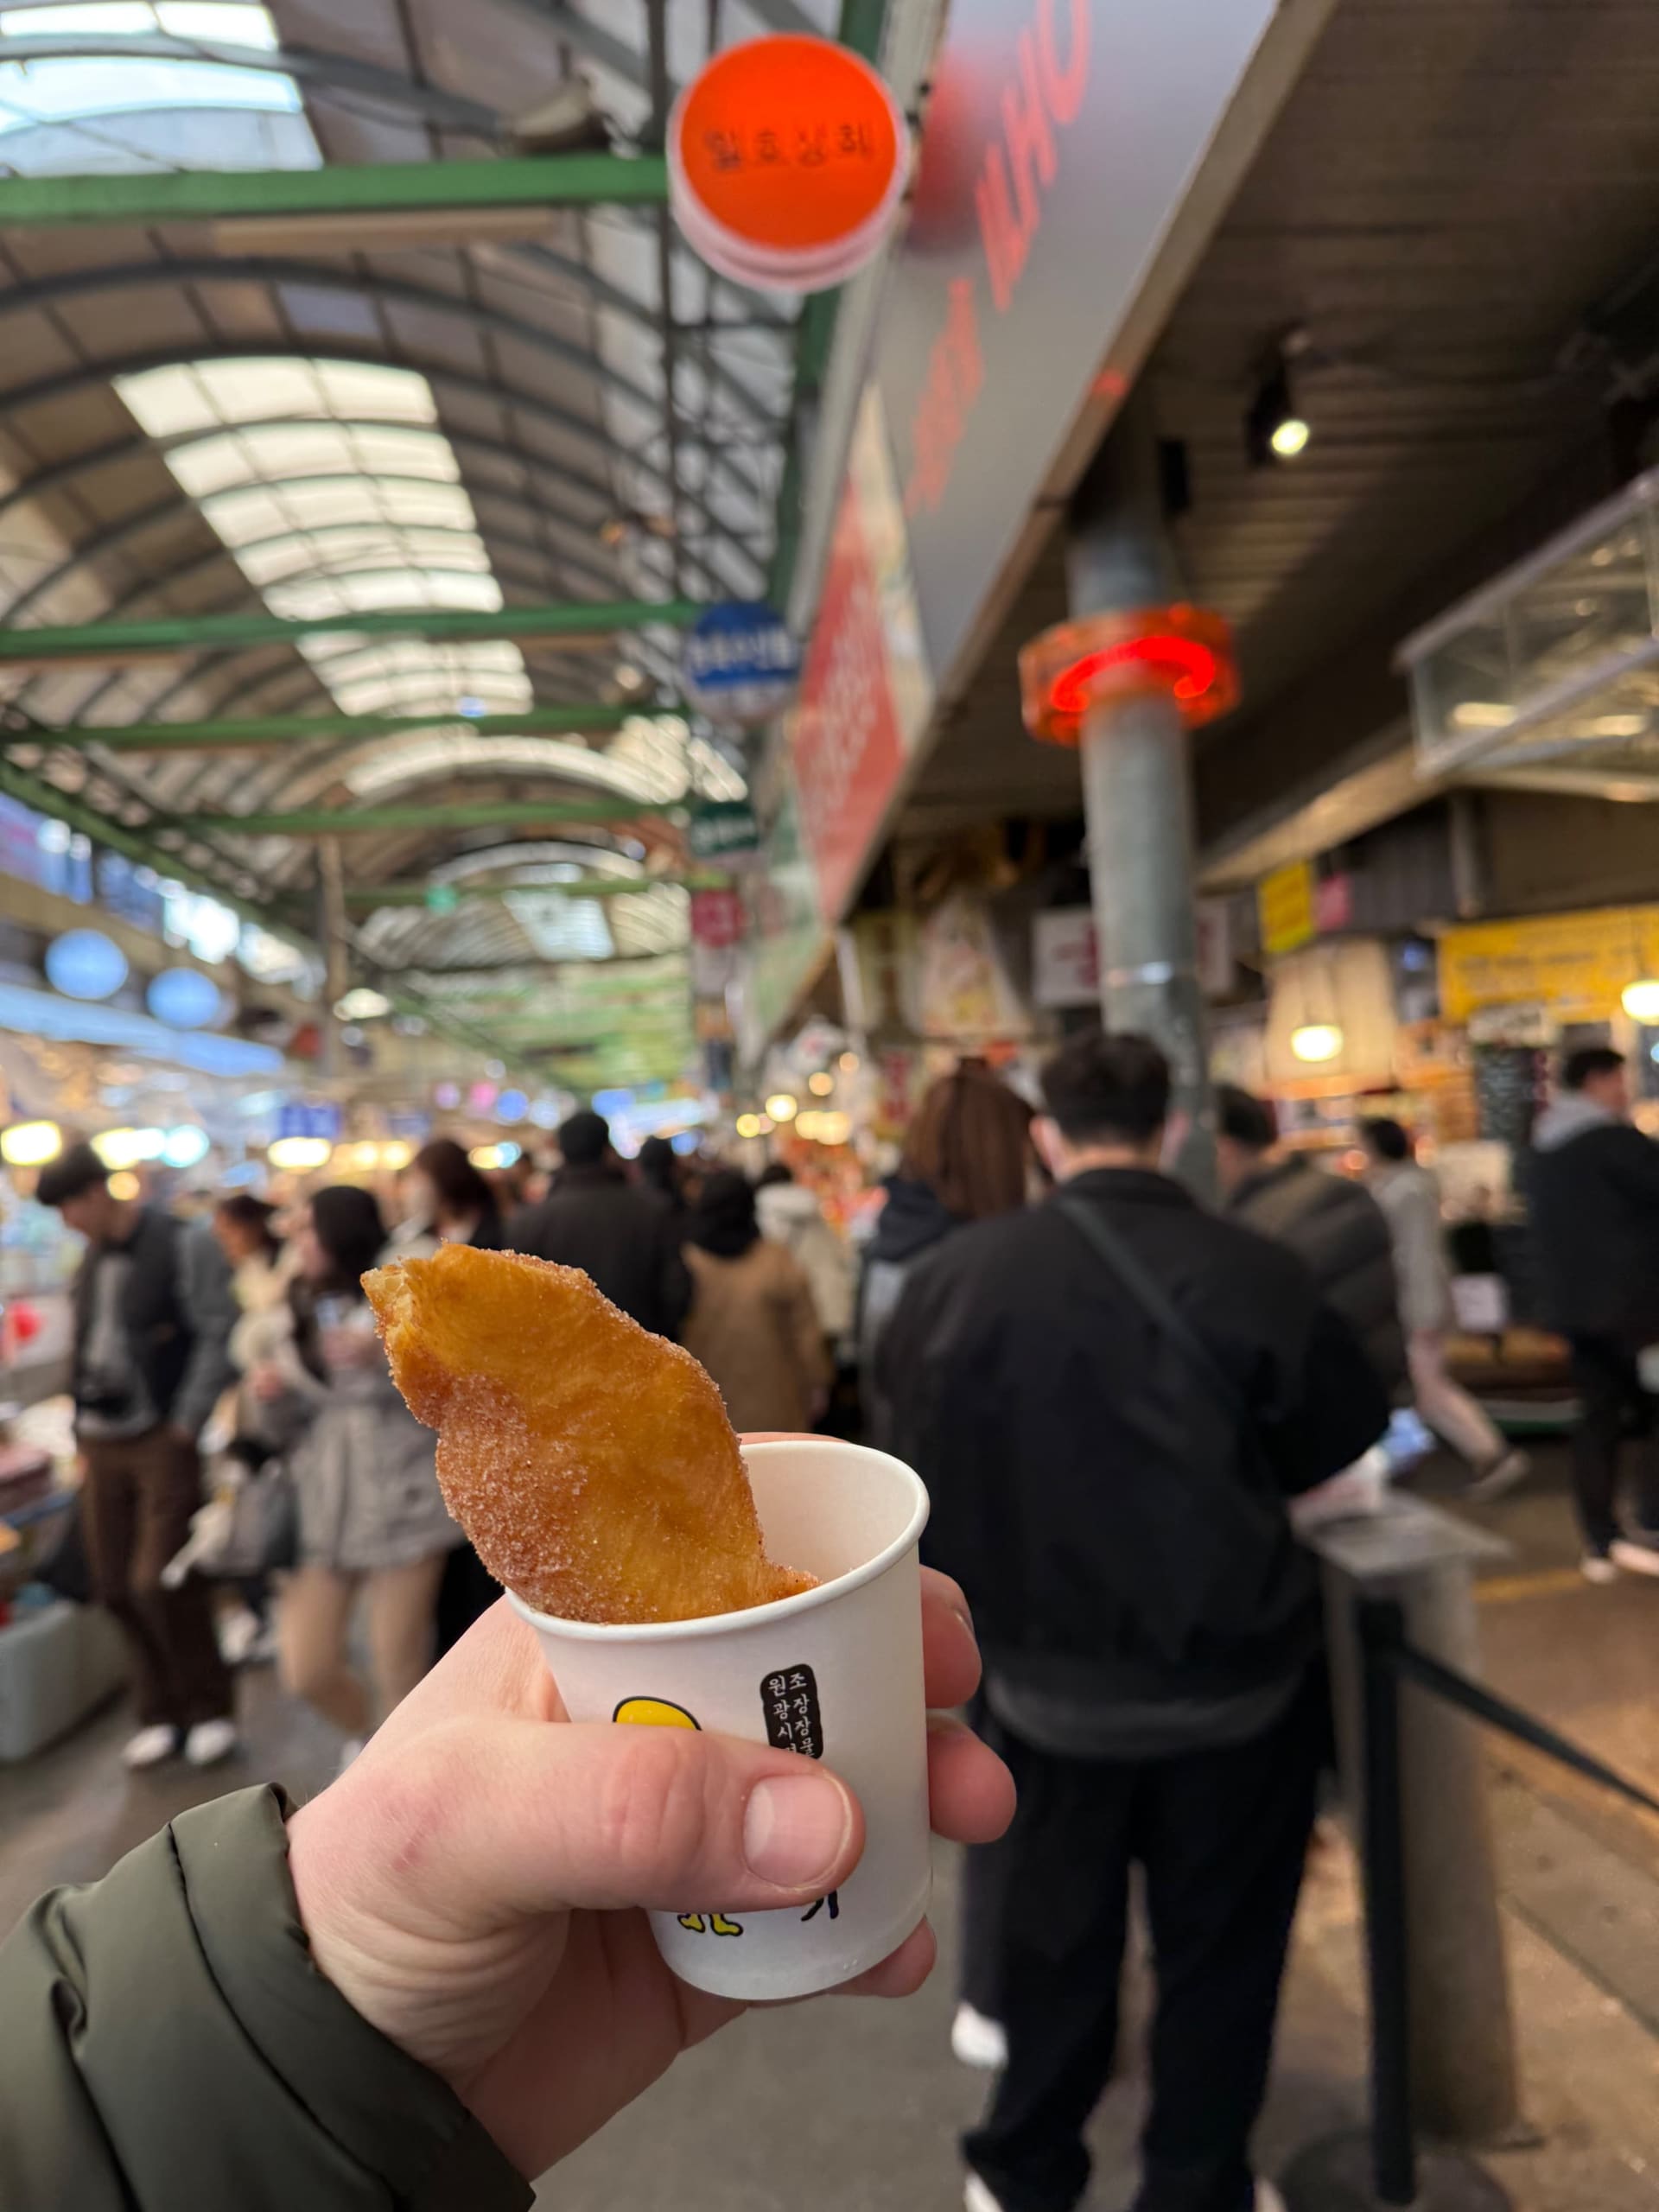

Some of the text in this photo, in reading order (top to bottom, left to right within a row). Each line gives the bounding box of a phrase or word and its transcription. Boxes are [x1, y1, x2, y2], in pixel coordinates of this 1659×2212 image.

[767, 1672, 808, 1697] 원조
[772, 1693, 810, 1720] 광장
[778, 1715, 811, 1740] 시장
